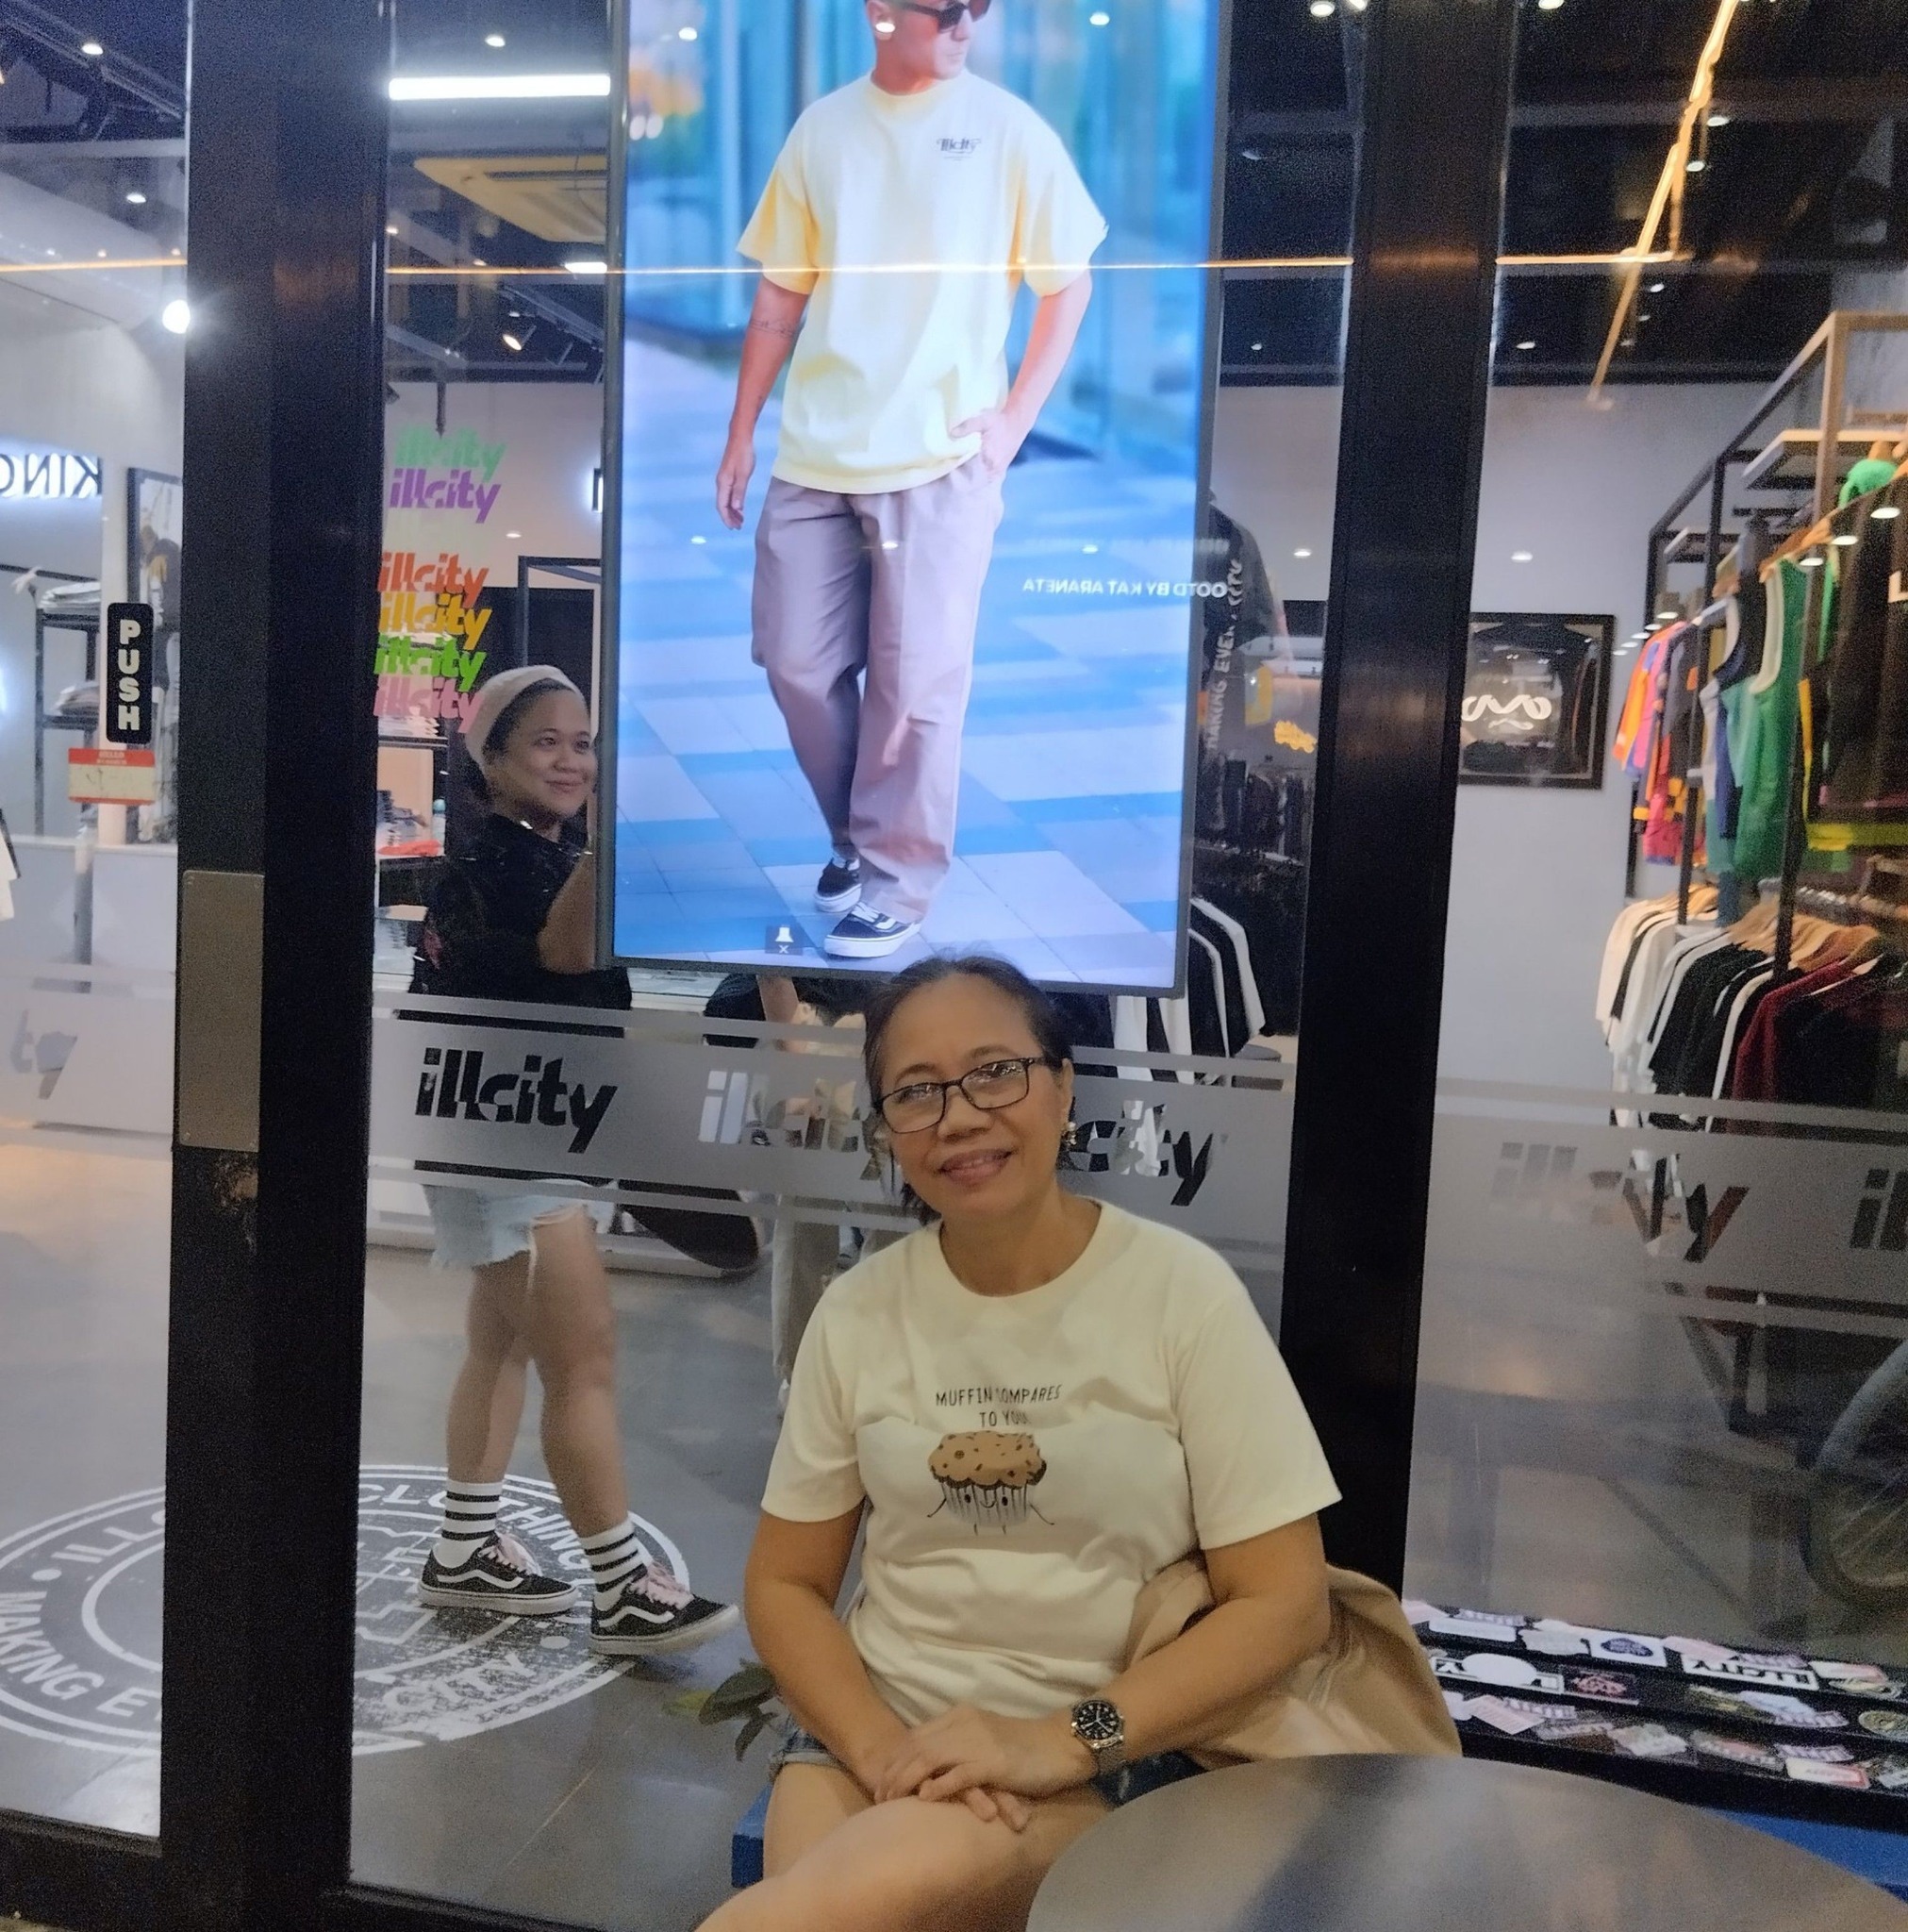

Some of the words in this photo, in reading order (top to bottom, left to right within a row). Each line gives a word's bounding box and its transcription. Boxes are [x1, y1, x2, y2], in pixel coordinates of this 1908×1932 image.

[389, 467, 503, 524] illcity
[378, 551, 489, 609] illcity
[378, 591, 493, 651] illcity
[117, 619, 141, 731] PUSH
[415, 1047, 618, 1154] illcity
[936, 1387, 992, 1407] MUFFIN
[979, 1410, 998, 1427] TO
